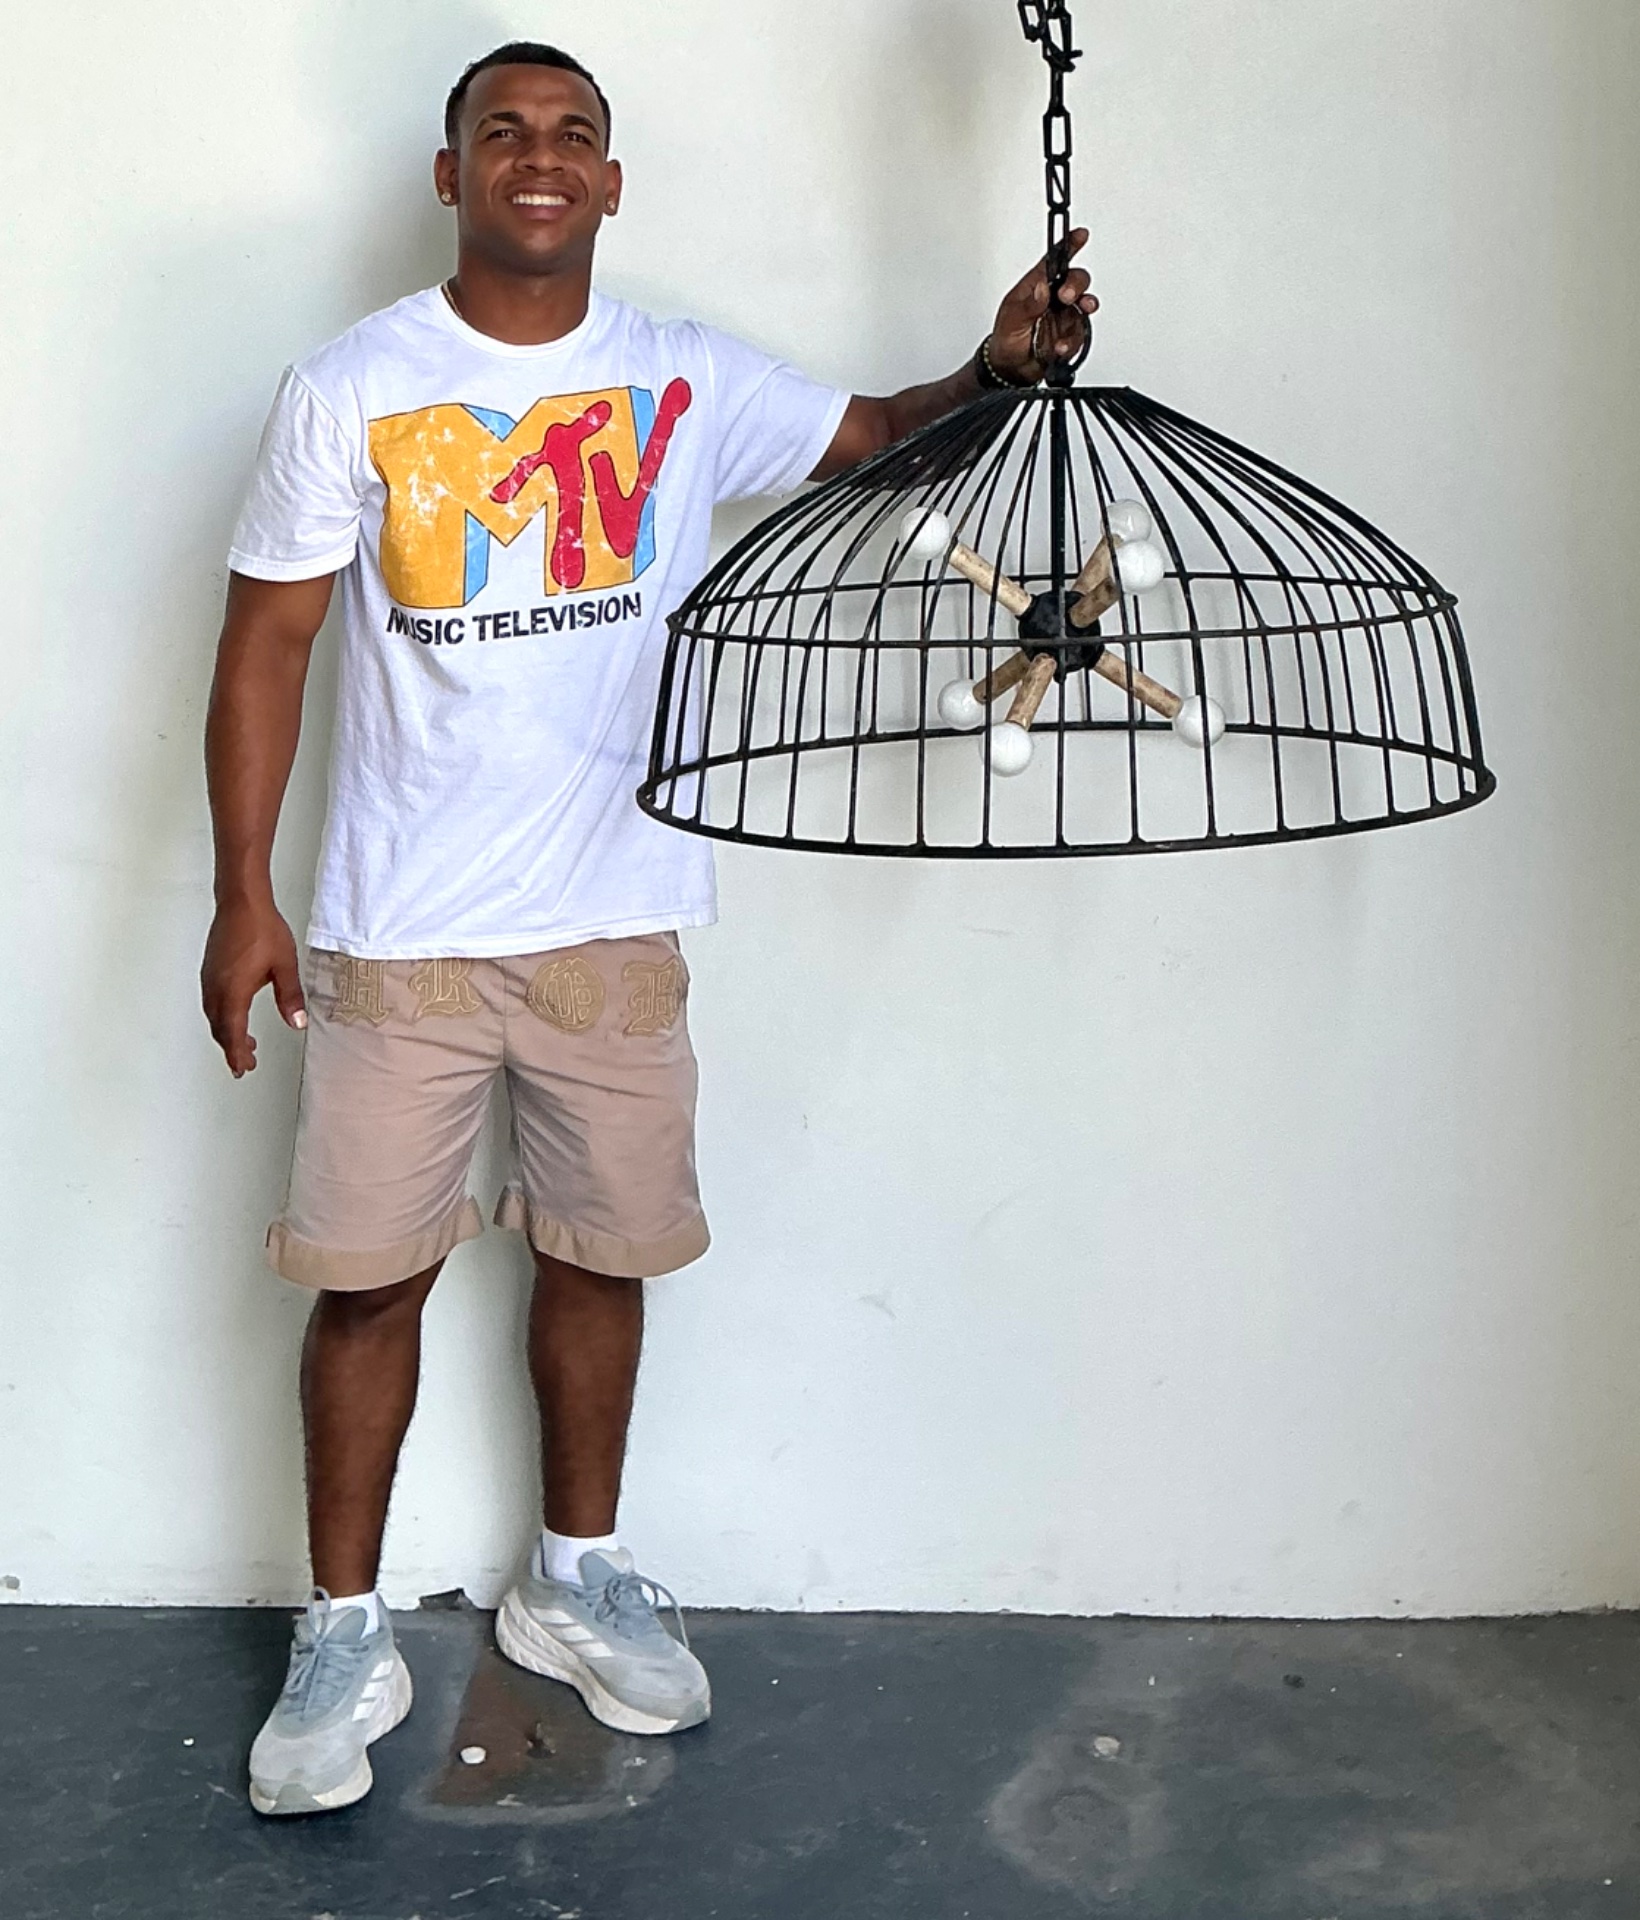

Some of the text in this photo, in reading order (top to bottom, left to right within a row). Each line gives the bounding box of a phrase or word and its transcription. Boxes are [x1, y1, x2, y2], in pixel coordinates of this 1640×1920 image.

[367, 376, 692, 609] MTV
[386, 592, 642, 646] MUSIC TELEVISION
